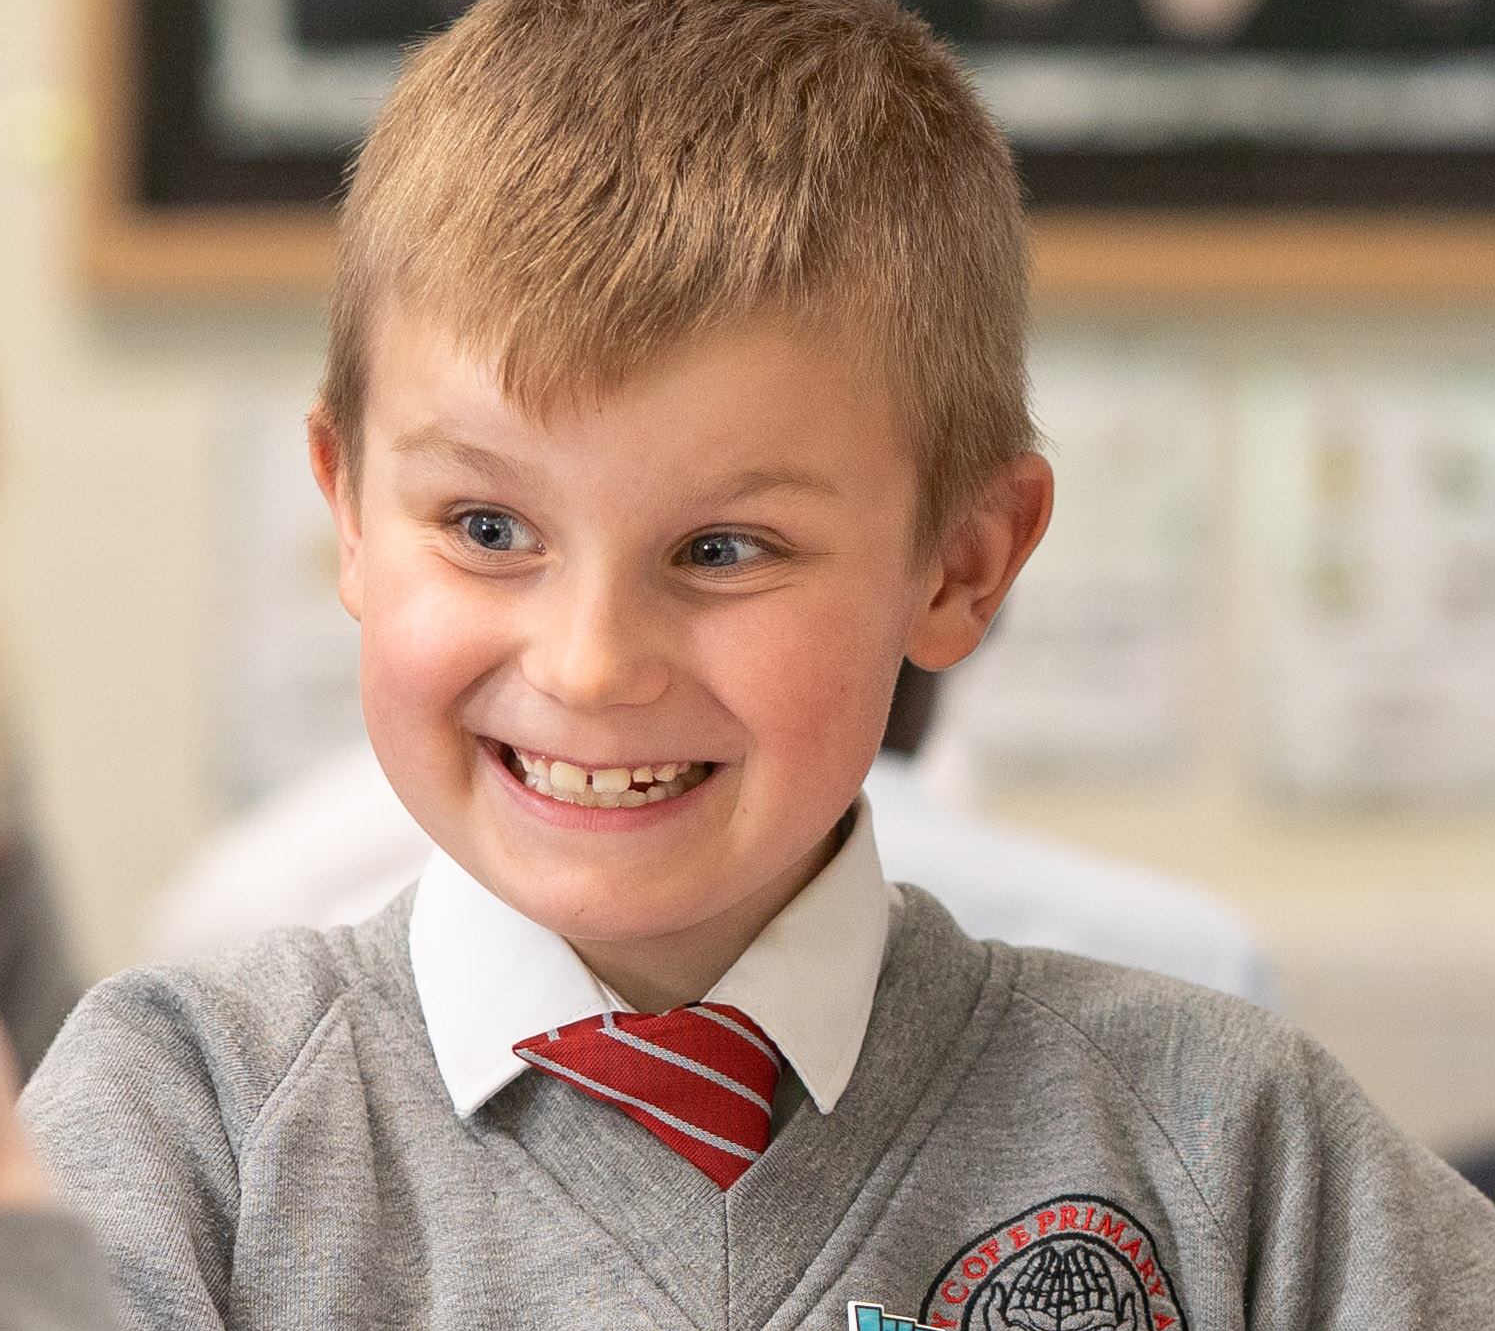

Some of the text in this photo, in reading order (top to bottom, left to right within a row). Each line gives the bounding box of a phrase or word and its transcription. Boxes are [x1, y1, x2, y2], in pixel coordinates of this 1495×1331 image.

[941, 1280, 970, 1304] C
[962, 1240, 1001, 1280] OF
[1008, 1226, 1031, 1250] E
[1035, 1205, 1165, 1296] PRIMARY
